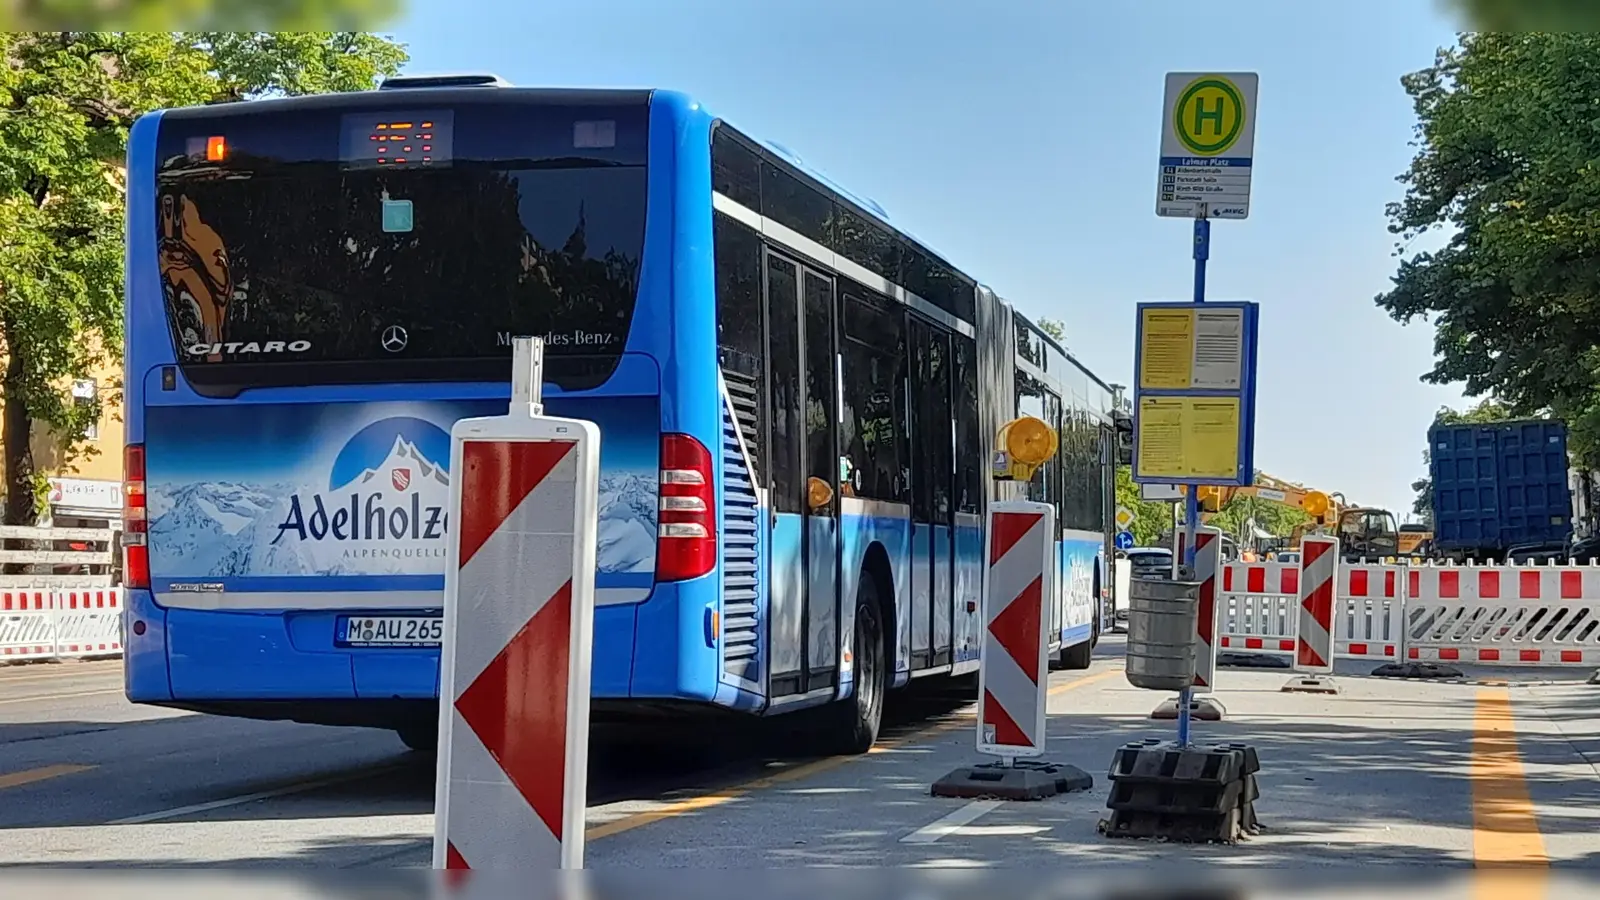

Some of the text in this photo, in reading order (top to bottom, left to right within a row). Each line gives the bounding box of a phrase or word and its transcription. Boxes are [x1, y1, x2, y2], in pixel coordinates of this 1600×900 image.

[1194, 97, 1223, 135] H
[1209, 158, 1230, 166] Platz
[188, 340, 312, 355] CITARO
[272, 492, 449, 545] Adelholz
[348, 620, 361, 639] M
[376, 620, 401, 639] AU
